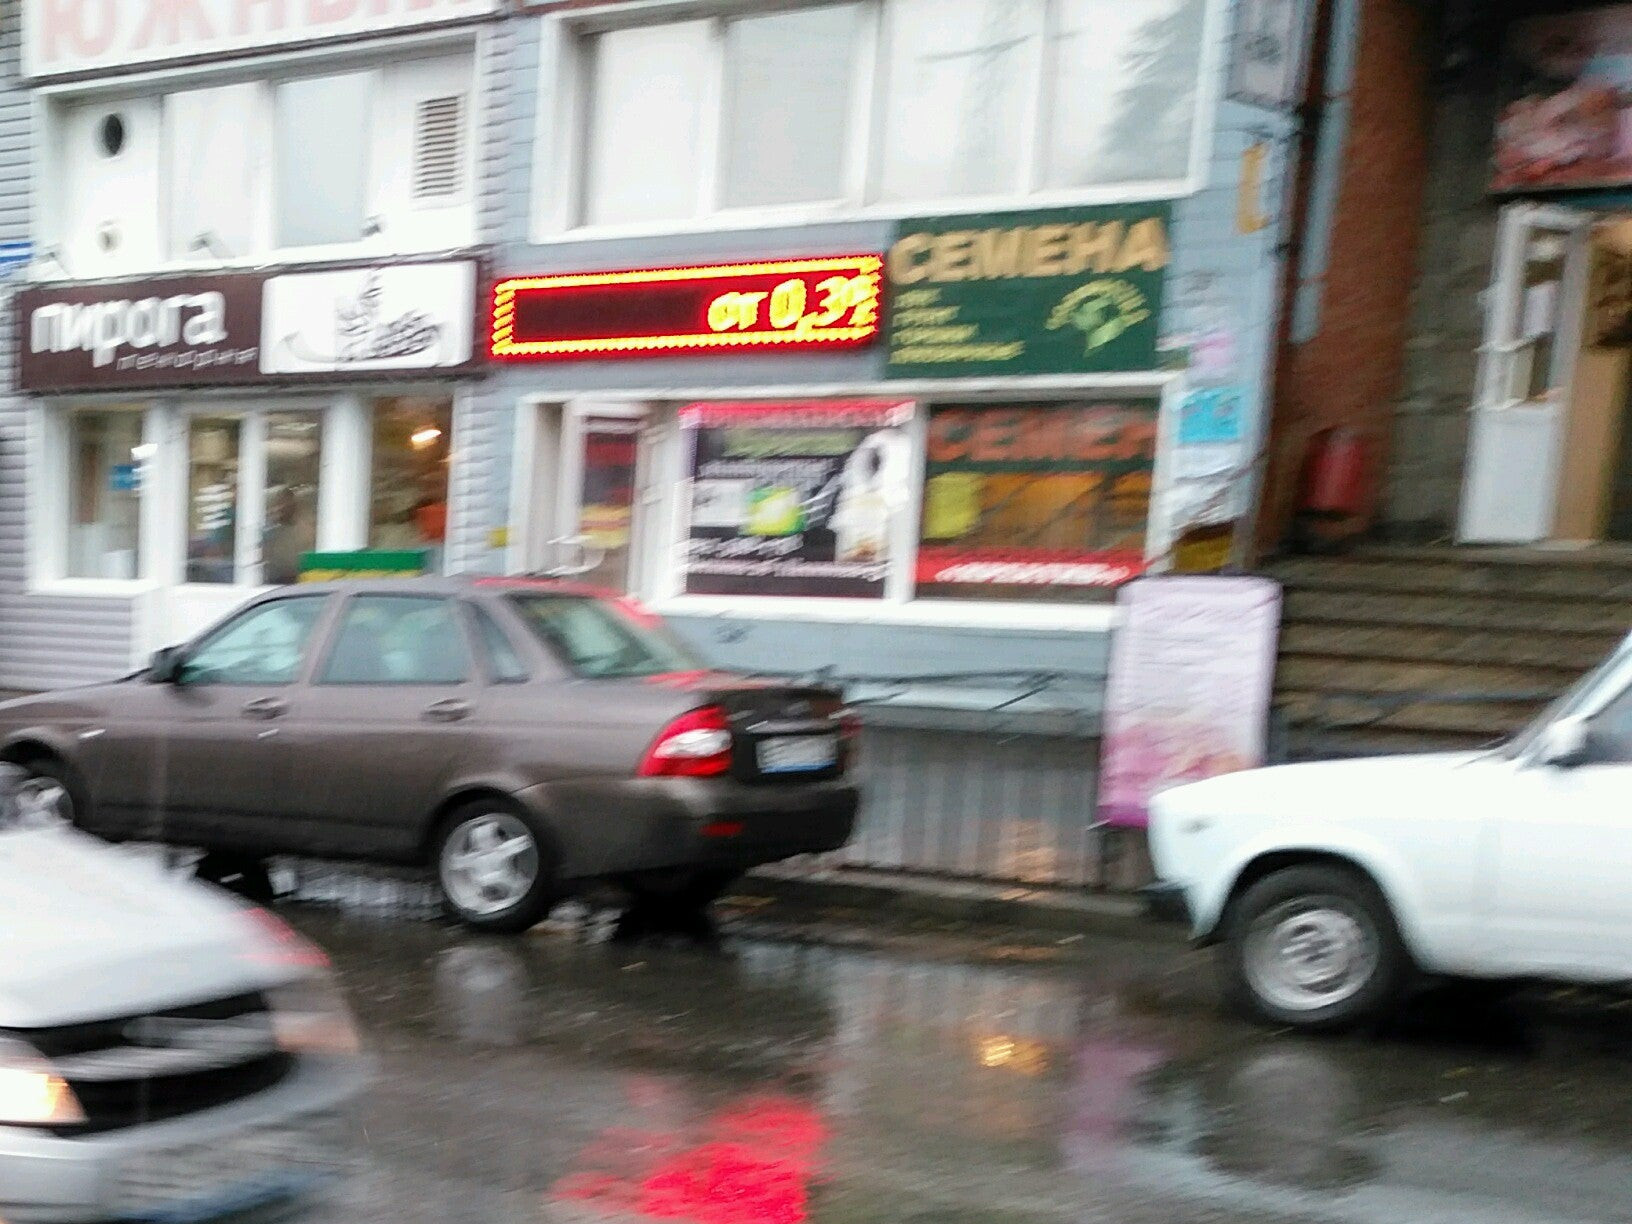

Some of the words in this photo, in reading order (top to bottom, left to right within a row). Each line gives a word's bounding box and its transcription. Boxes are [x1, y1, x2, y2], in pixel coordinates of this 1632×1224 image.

[38, 0, 483, 62] ЮЖН
[888, 215, 1171, 285] СЕМЕНА
[31, 290, 228, 368] пирога
[707, 291, 769, 332] от
